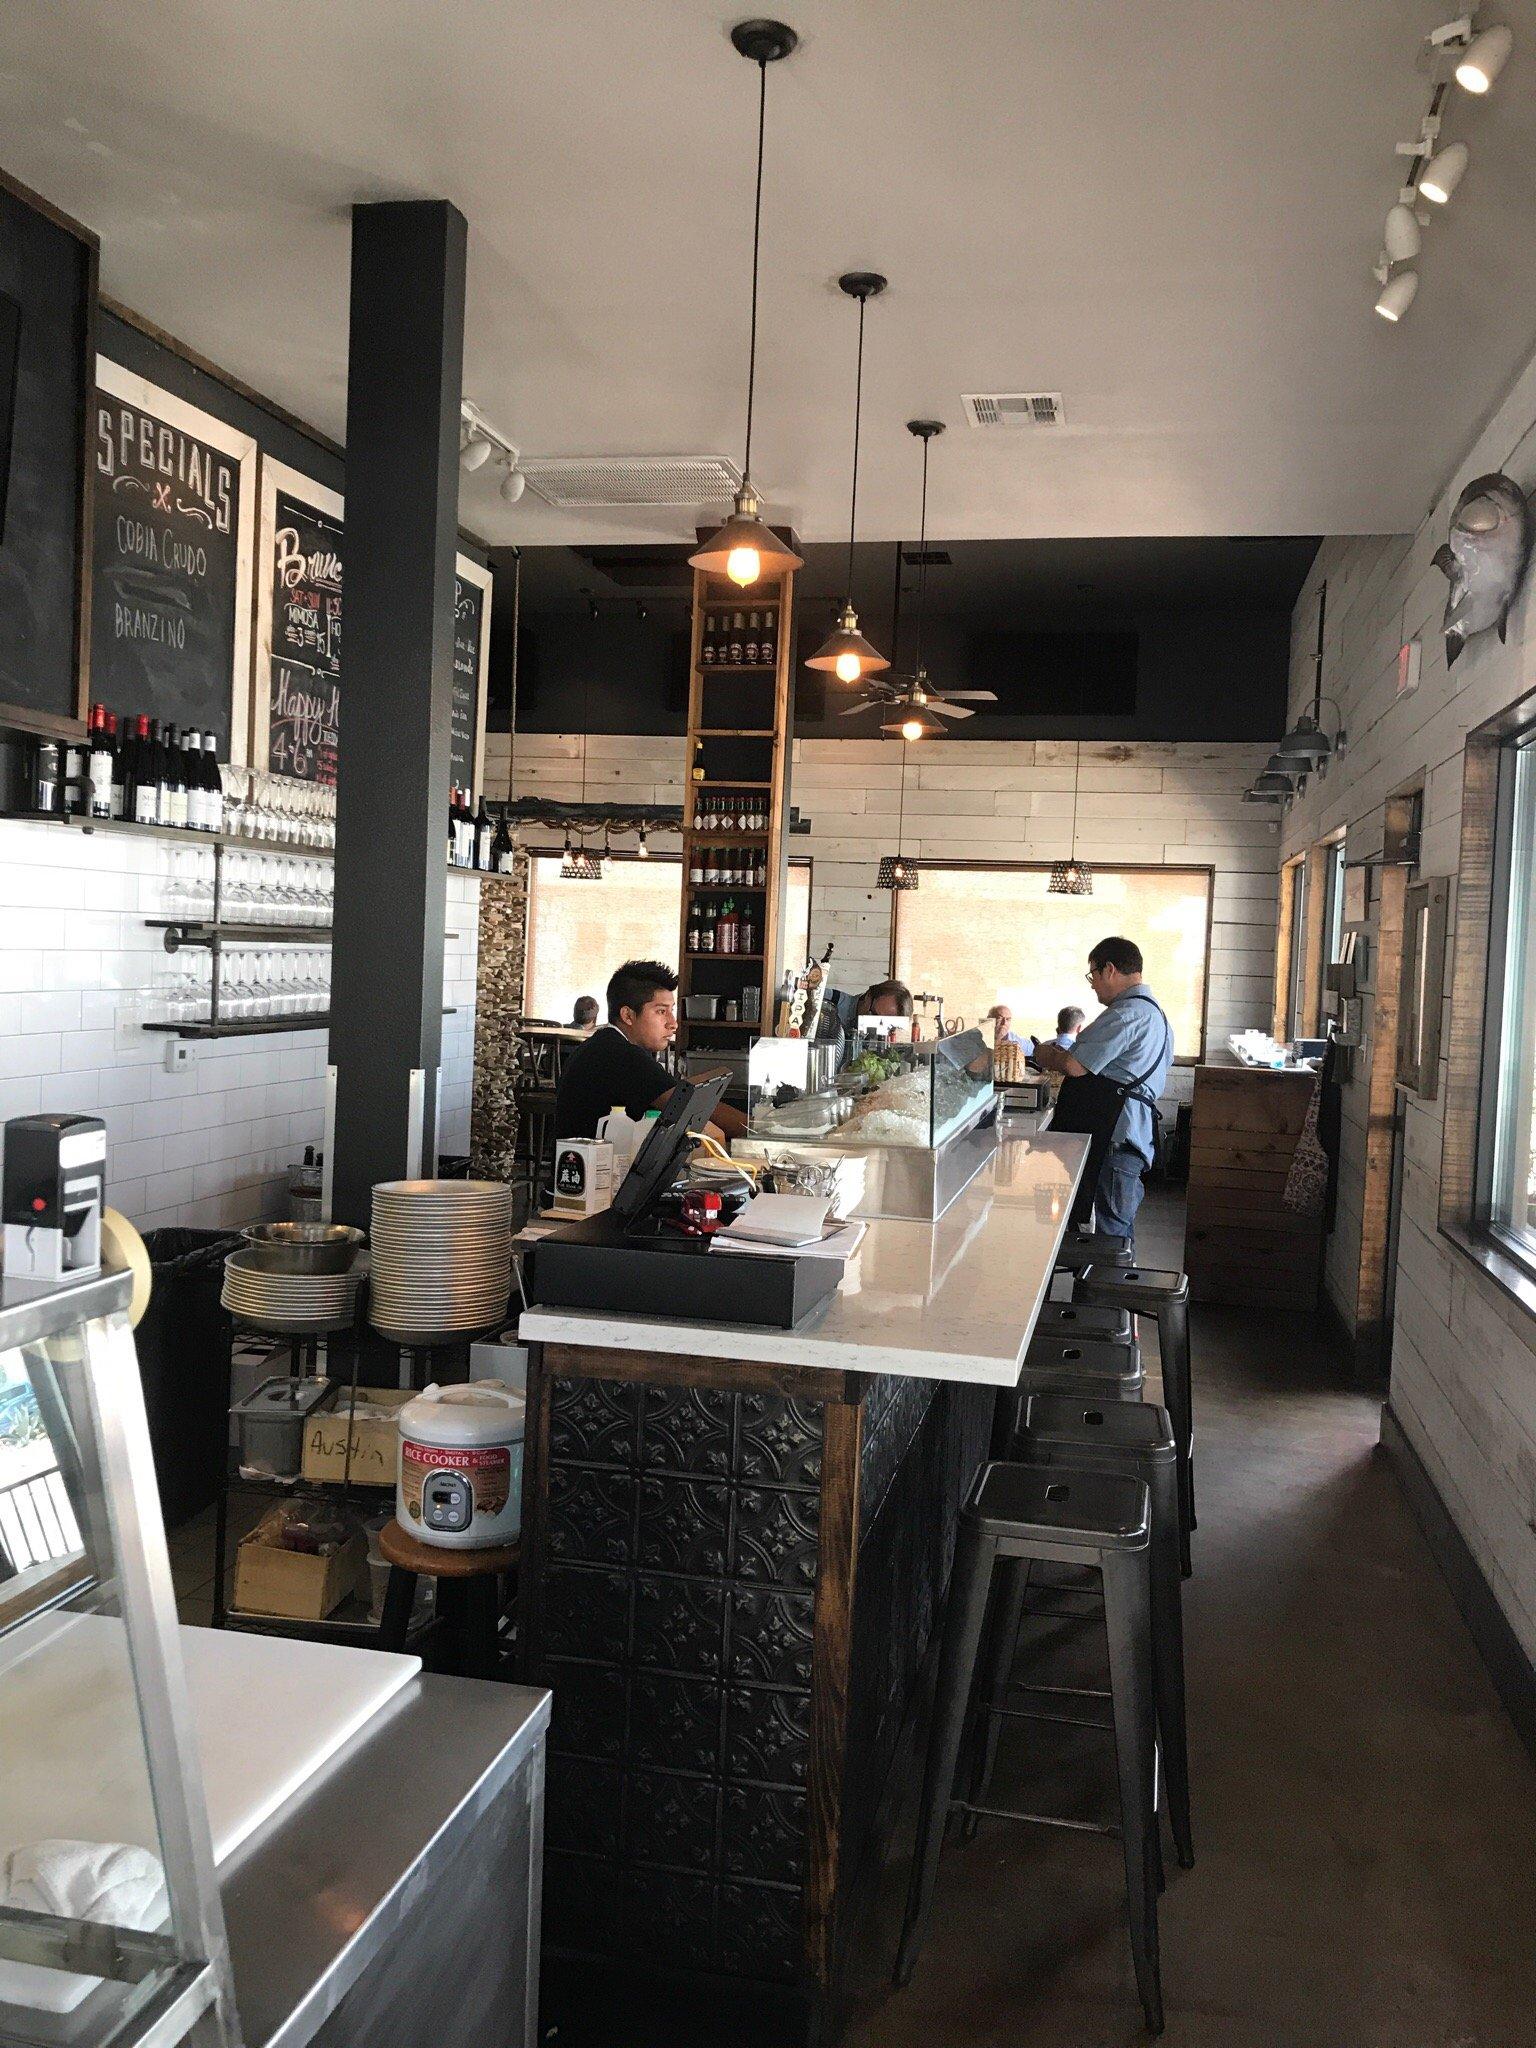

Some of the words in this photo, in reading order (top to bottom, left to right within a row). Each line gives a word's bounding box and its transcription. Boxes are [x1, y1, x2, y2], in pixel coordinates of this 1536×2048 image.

[98, 409, 231, 535] SPECIALS
[117, 515, 158, 562] COBIA
[115, 602, 186, 650] BRANZINO
[288, 605, 319, 630] MIMOSA
[271, 668, 325, 747] Happy
[404, 1446, 422, 1462] RICE
[423, 1452, 470, 1467] COOKER
[479, 1453, 498, 1461] FOOD
